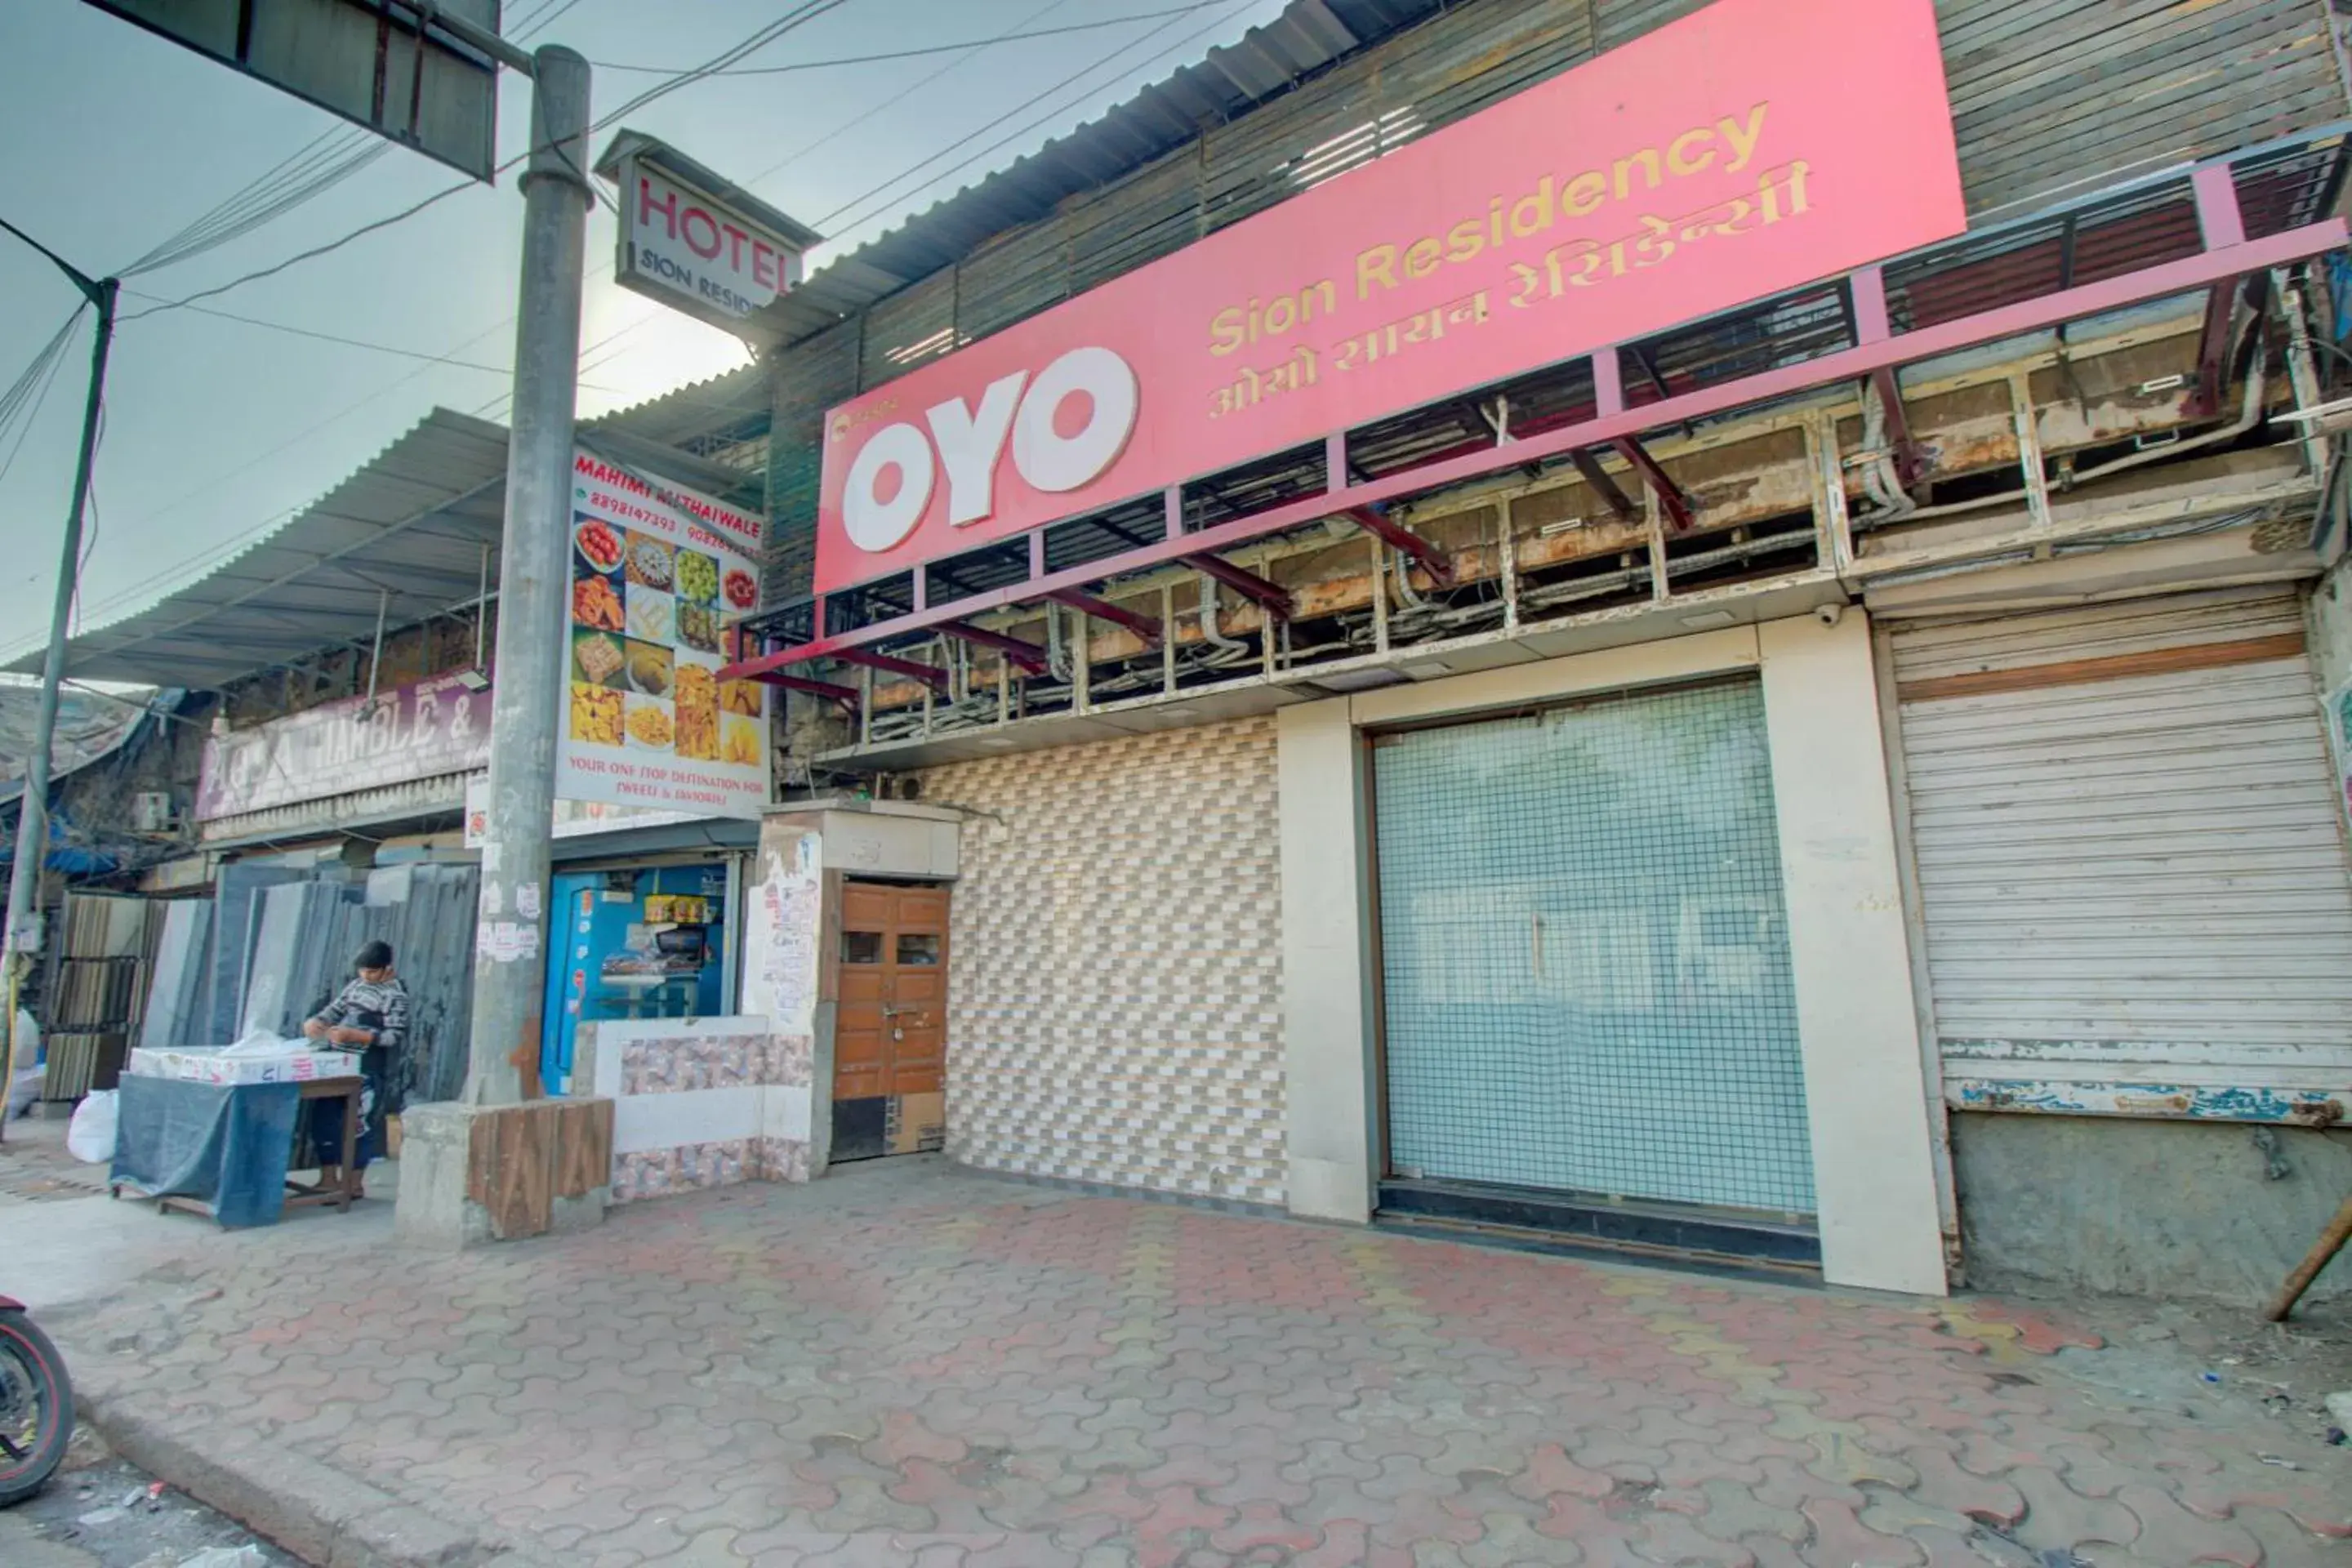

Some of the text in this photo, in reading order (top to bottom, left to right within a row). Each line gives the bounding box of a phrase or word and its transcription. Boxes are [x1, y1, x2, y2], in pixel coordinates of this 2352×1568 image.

[640, 247, 693, 287] SION
[1209, 100, 1770, 357] Sion Residency
[842, 346, 1140, 553] OYO
[569, 756, 606, 773] YOUR
